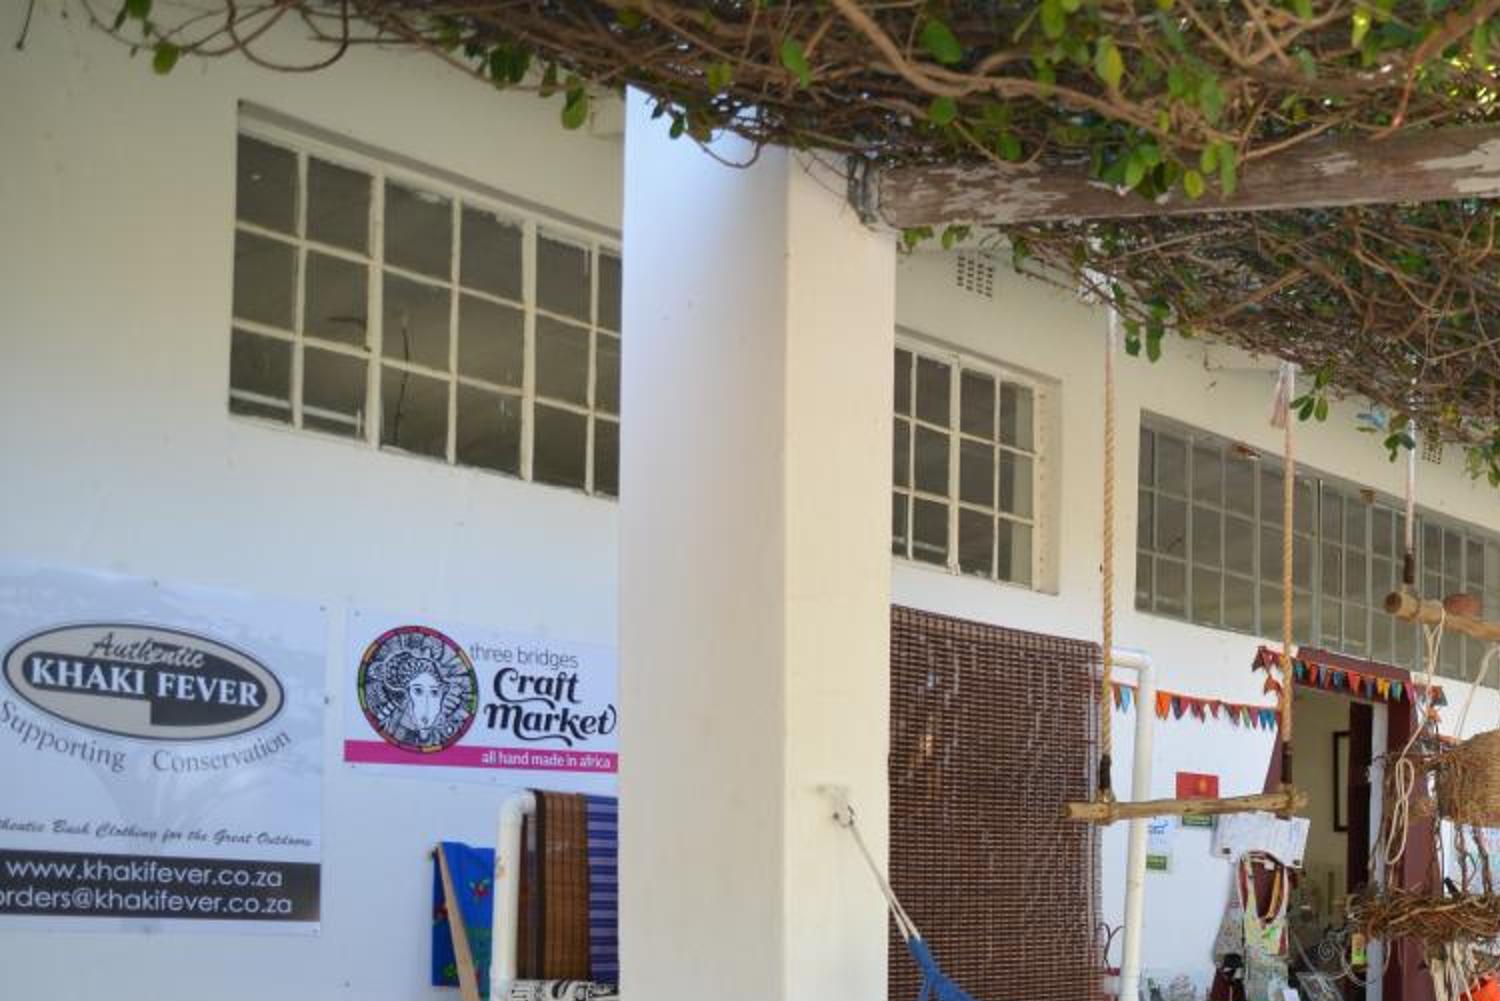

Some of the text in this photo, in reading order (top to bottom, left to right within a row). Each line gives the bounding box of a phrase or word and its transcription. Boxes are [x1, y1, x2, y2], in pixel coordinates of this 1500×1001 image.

[87, 632, 206, 669] Authentic
[469, 643, 580, 671] three bridges
[31, 656, 261, 707] KHAKI FEVER
[493, 667, 583, 711] Craft
[0, 700, 292, 774] Supporting Conservation
[483, 703, 618, 748] Market
[481, 751, 612, 770] all hand made in africa
[95, 821, 158, 839] Clothing
[161, 828, 182, 844] for
[187, 828, 209, 842] the
[213, 828, 253, 845] Great
[5, 859, 284, 888] www.khakifever.co.za
